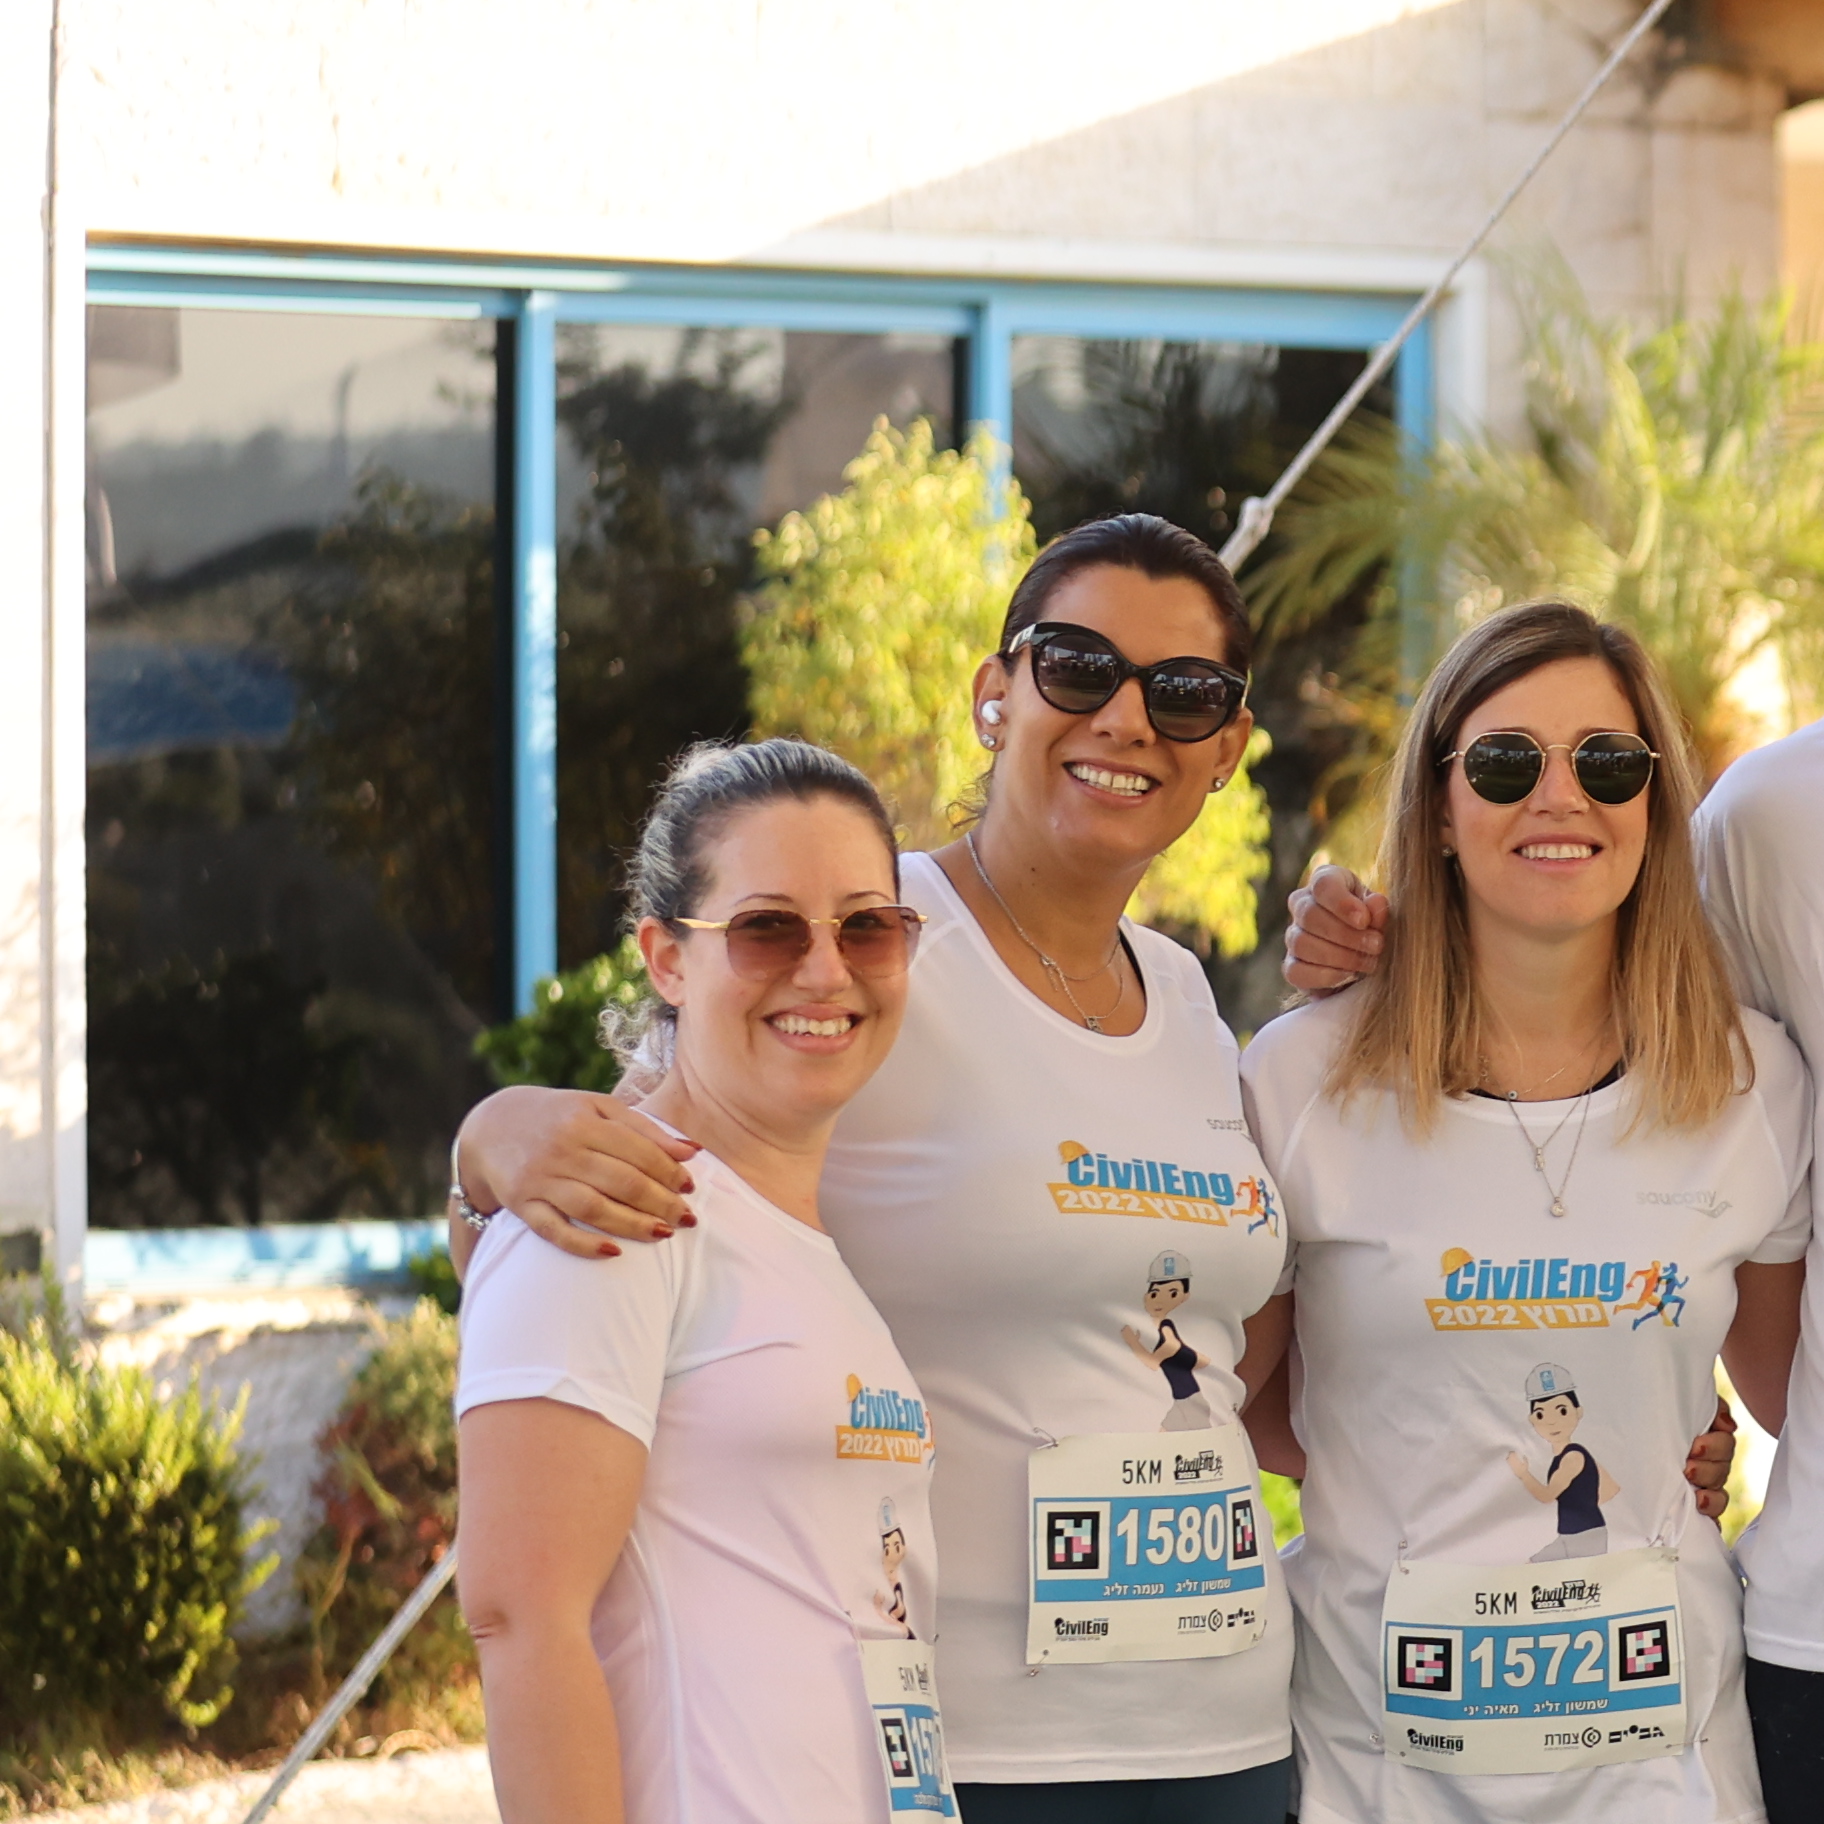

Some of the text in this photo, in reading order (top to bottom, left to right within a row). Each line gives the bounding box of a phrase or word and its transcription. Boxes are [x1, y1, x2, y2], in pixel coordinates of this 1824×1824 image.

[1068, 1153, 1236, 1206] CivilEng
[1055, 1189, 1221, 1222] מרוץ 2022
[1445, 1257, 1626, 1302] CivilEng
[1432, 1302, 1601, 1328] מרוץ 2022
[851, 1386, 925, 1439] CivilEng
[840, 1433, 883, 1455] 2022
[1122, 1460, 1162, 1484] 5KM
[1117, 1503, 1226, 1565] 1580
[1103, 1578, 1232, 1597] שמשון זליג נעמה זליג
[1475, 1592, 1518, 1615] 5KM
[1056, 1620, 1109, 1636] CivilEng
[1178, 1614, 1207, 1630] צמרת
[1469, 1630, 1605, 1688] 1572
[1483, 1704, 1520, 1715] מאיה
[1533, 1701, 1562, 1714] זליג
[1565, 1699, 1609, 1714] שמשון
[1409, 1730, 1465, 1752] CivilEng
[1544, 1732, 1580, 1746] צמרת
